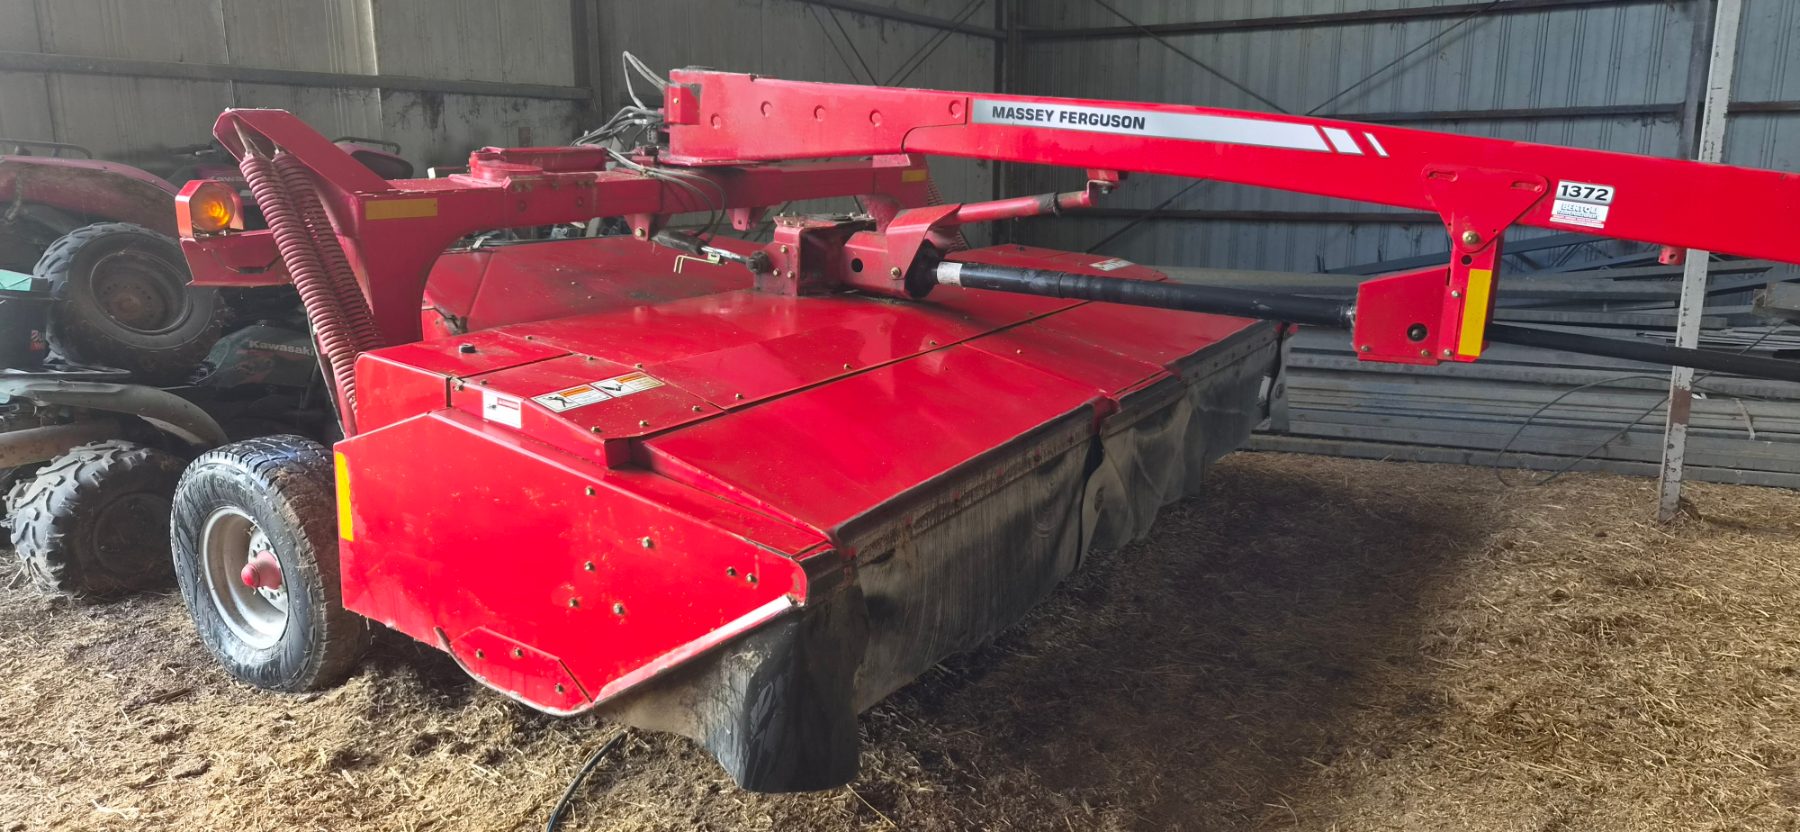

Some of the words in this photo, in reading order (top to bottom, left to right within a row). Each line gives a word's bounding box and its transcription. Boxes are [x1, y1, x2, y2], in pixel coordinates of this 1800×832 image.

[992, 105, 1054, 122] MASSEY
[1059, 110, 1146, 130] FERGUSON
[1561, 184, 1609, 201] 1372
[249, 340, 314, 357] Kawasaki
